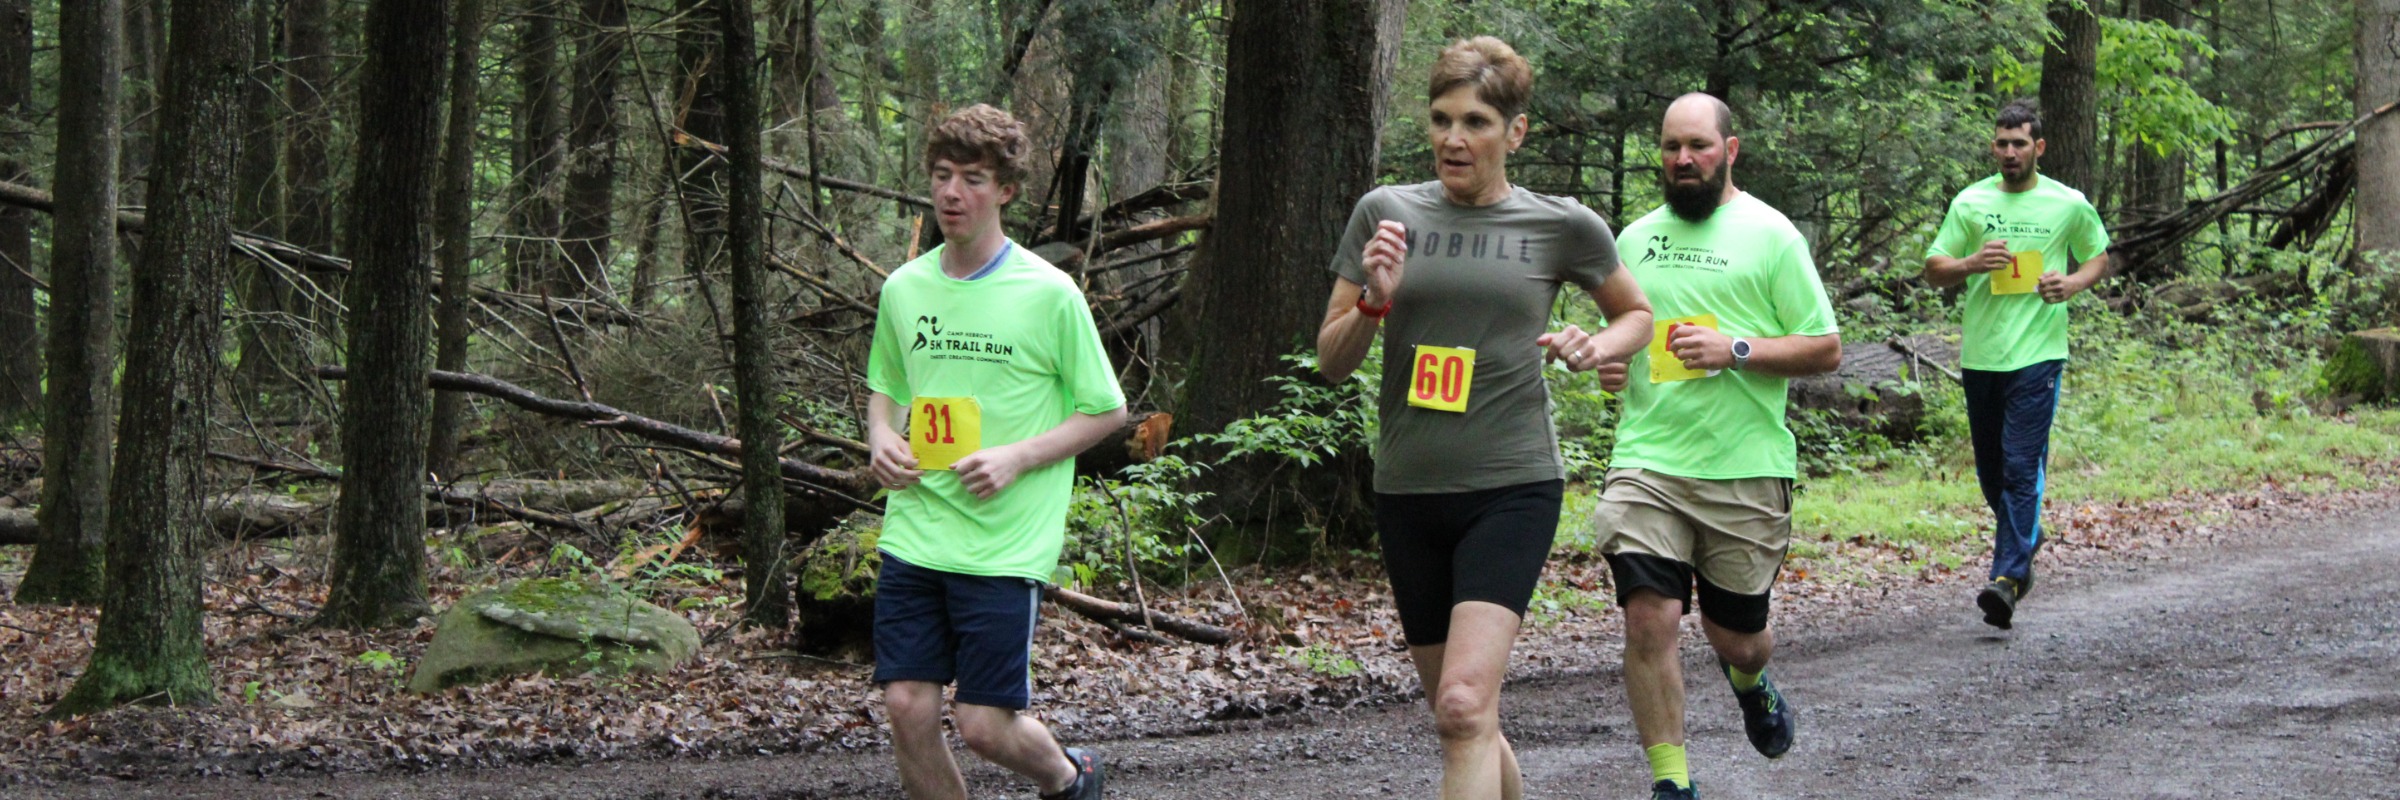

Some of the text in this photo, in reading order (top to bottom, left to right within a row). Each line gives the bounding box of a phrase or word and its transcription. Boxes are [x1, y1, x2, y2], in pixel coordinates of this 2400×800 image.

[2010, 226, 2032, 234] TRAIL
[1406, 228, 1532, 264] NOBULL
[1657, 253, 1729, 266] 5K TRAIL RUN
[2011, 256, 2021, 278] 1
[930, 339, 1013, 356] 5K TRAIL RUN
[1416, 353, 1464, 402] 60
[923, 403, 955, 444] 31
